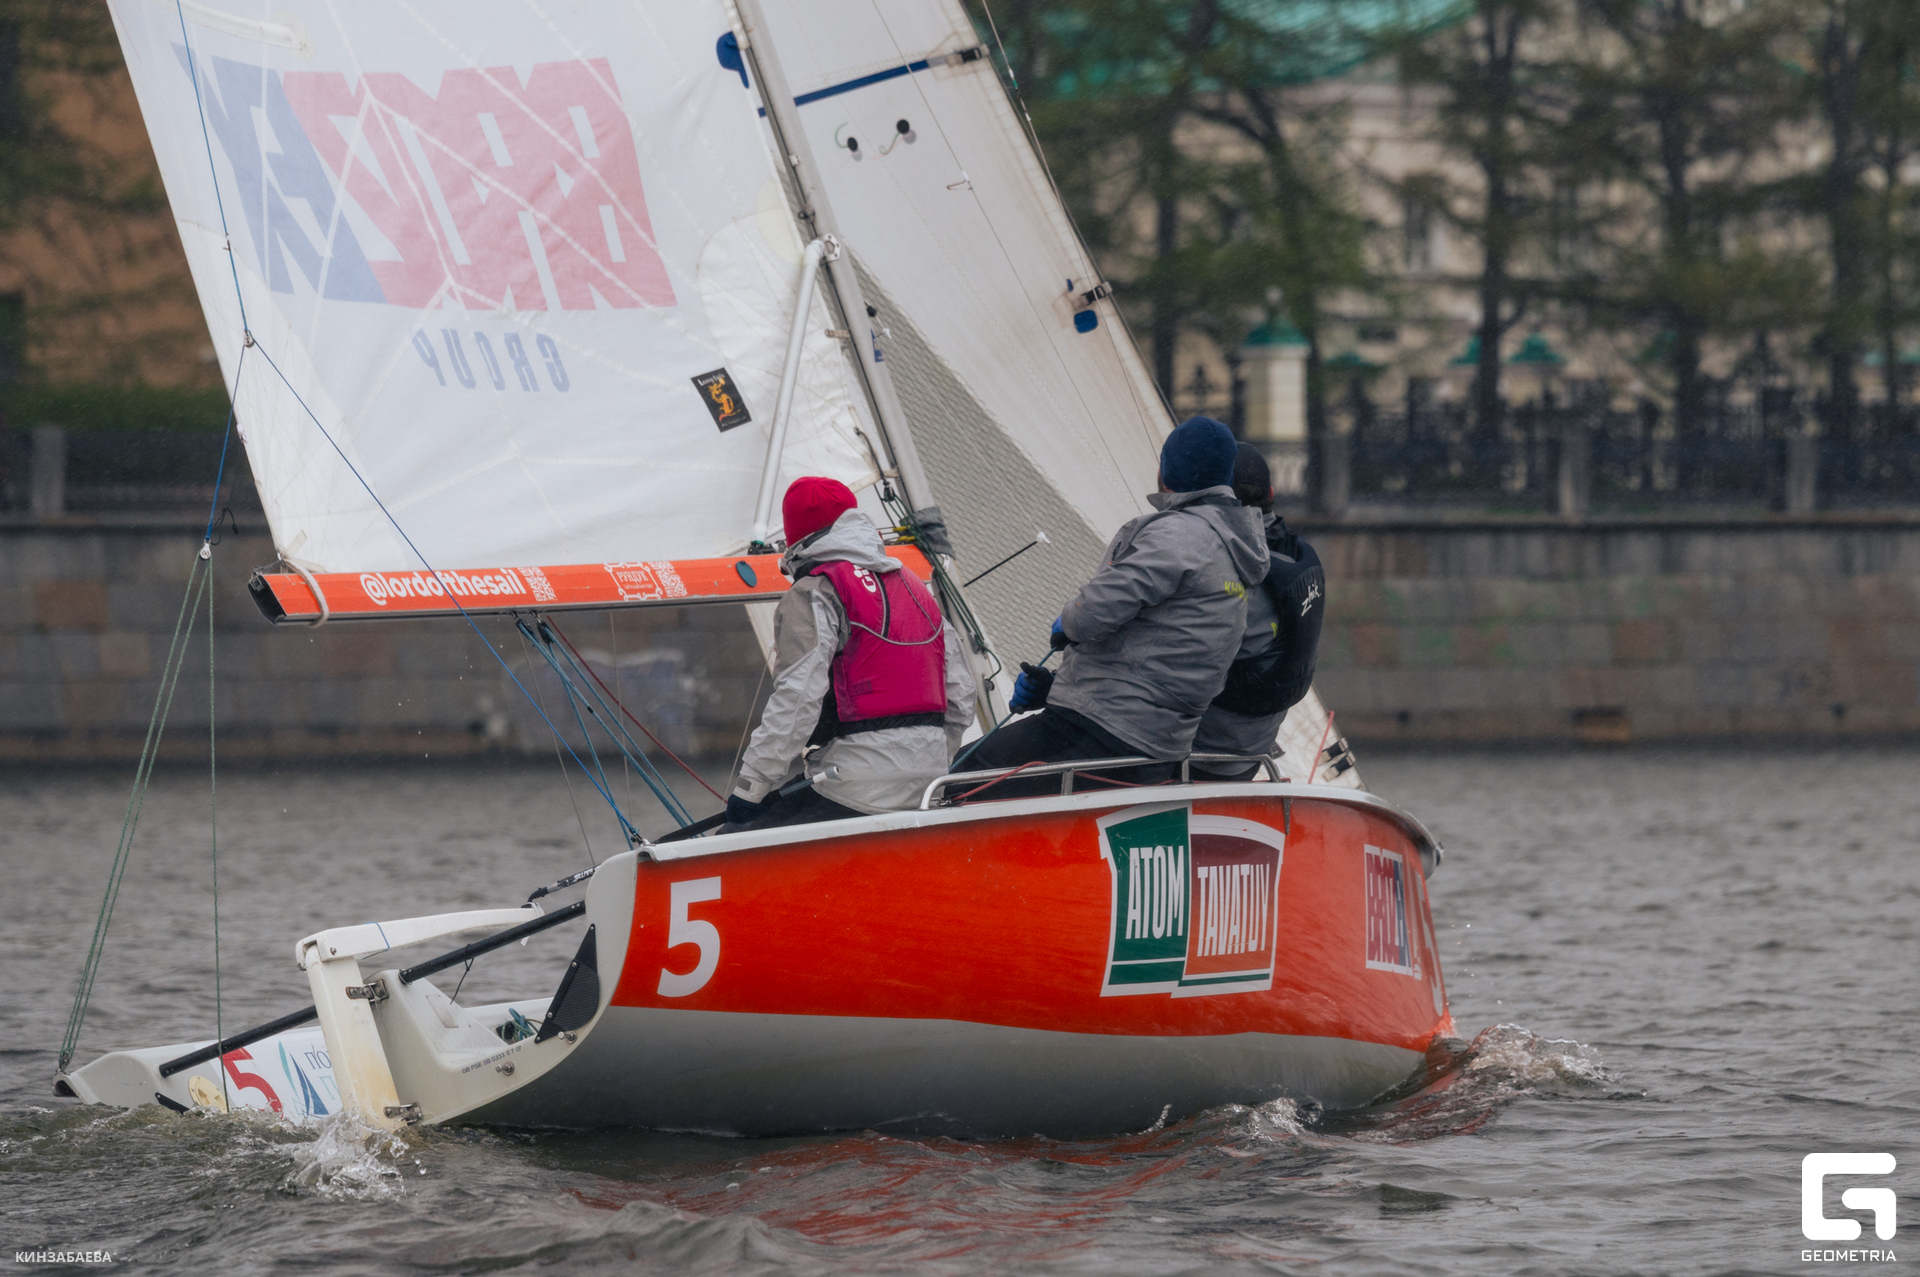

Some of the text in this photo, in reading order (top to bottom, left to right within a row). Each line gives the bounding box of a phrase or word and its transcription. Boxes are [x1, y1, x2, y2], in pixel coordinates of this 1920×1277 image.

[360, 568, 526, 606] @lordofthesail
[616, 570, 649, 584] РУНДУК
[1125, 845, 1184, 939] ATOM
[1197, 863, 1270, 957] TAVATUY
[656, 876, 722, 998] 5
[219, 1047, 284, 1119] 5
[470, 1062, 482, 1071] PSE
